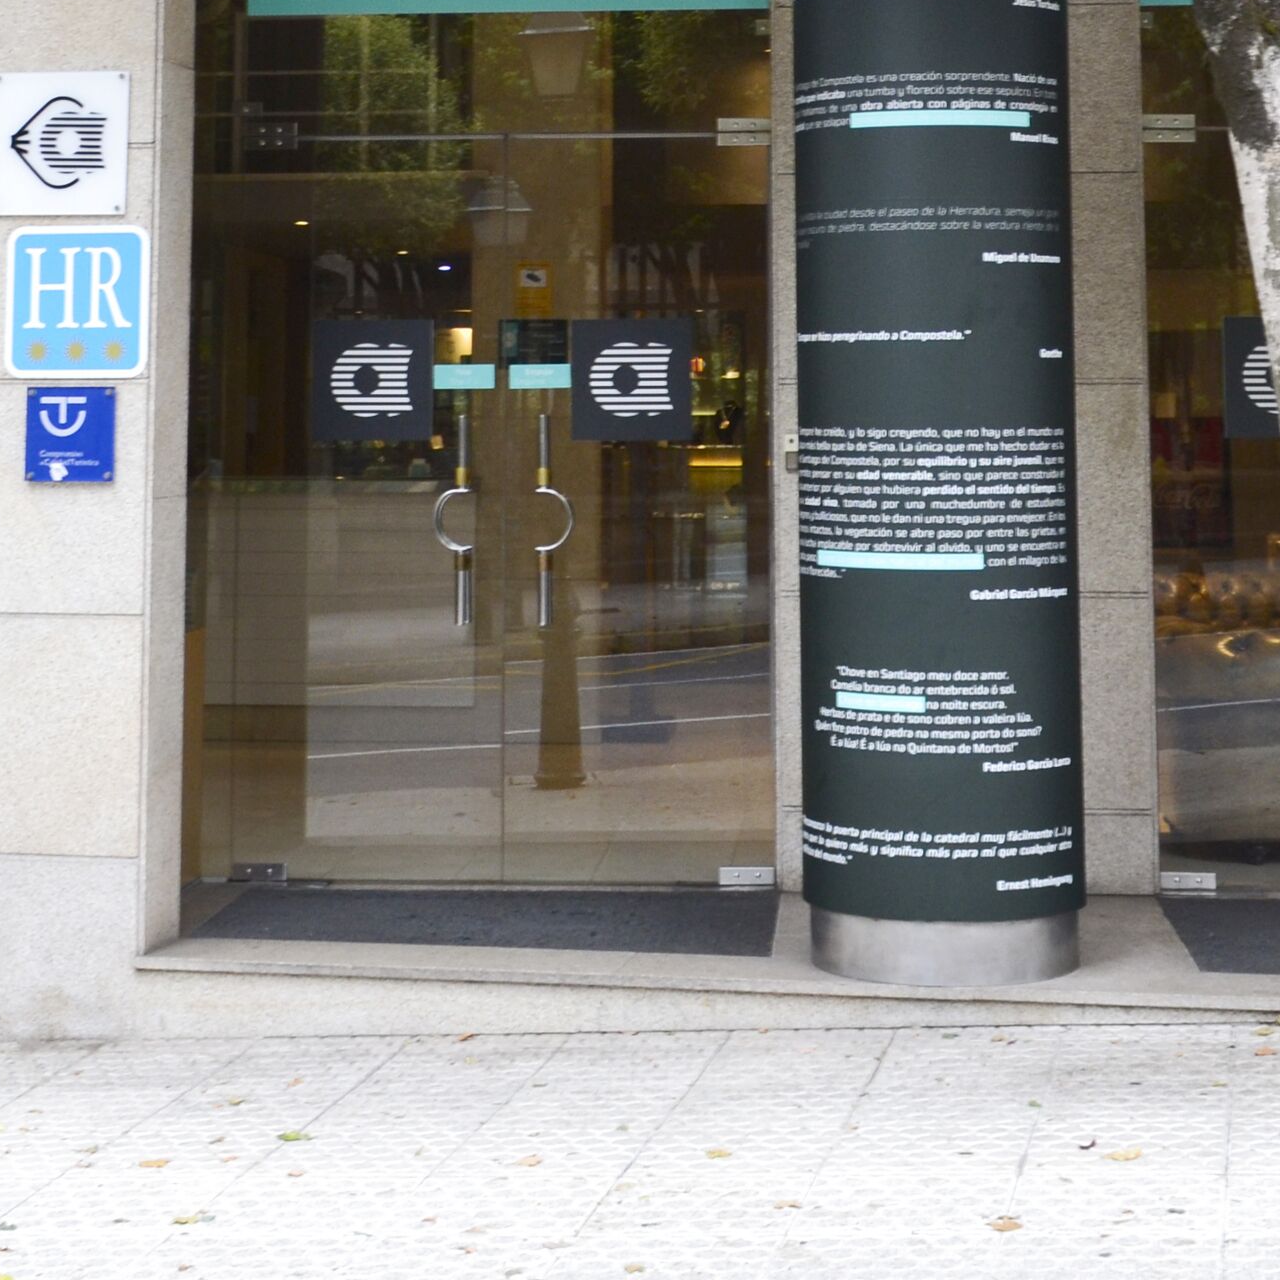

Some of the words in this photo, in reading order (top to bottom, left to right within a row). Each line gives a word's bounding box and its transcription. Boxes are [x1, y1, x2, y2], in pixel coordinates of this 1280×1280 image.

[879, 72, 898, 82] una
[899, 70, 942, 81] creación
[864, 87, 896, 97] tumba
[905, 84, 944, 95] floreció
[946, 84, 976, 95] sobre
[977, 86, 993, 95] ese
[860, 101, 883, 111] obra
[885, 99, 924, 110] abierta
[927, 100, 947, 109] con
[950, 98, 991, 110] páginas
[849, 208, 875, 218] desde
[888, 208, 919, 218] paseo
[921, 206, 935, 216] de
[869, 220, 937, 231] destacándose
[939, 220, 970, 231] sobre
[984, 221, 1021, 231] verdura
[982, 251, 1017, 264] Miguel
[22, 246, 133, 329] HR
[832, 330, 891, 343] peregrinando
[866, 427, 887, 439] sigo
[889, 426, 940, 439] creyendo,
[942, 428, 963, 439] que
[965, 429, 979, 438] no
[981, 426, 1000, 439] hay
[1002, 428, 1015, 437] en
[868, 441, 898, 452] Siena.
[900, 441, 913, 452] La
[915, 441, 943, 452] única
[945, 443, 965, 453] que
[966, 443, 984, 451] me
[985, 441, 999, 451] ha
[1000, 440, 1029, 451] hecho
[830, 454, 881, 466] Compostela,
[883, 457, 901, 467] por
[902, 458, 916, 467] su
[917, 455, 967, 468] equilibrio
[978, 457, 992, 466] su
[992, 455, 1012, 466] aire
[856, 469, 880, 480] edad
[881, 469, 936, 481] venerable,
[938, 470, 961, 481] sino
[963, 471, 984, 482] que
[985, 471, 1019, 482] parece
[833, 484, 862, 495] alguien
[863, 485, 881, 495] que
[882, 484, 921, 495] hubiera
[922, 484, 963, 496] perdido
[977, 484, 1015, 495] sentido
[1015, 483, 1030, 494] del
[842, 498, 877, 509] tomada
[881, 500, 900, 510] por
[905, 501, 926, 510] una
[930, 498, 1006, 509] muchedumbre
[1009, 498, 1023, 509] de
[868, 514, 881, 523] no
[892, 513, 911, 523] dan
[925, 515, 944, 524] una
[945, 514, 981, 526] tregua
[982, 515, 1006, 525] para
[844, 527, 893, 539] vegetación
[895, 529, 908, 538] se
[909, 528, 935, 538] abre
[936, 529, 963, 539] paso
[965, 529, 984, 539] por
[985, 527, 1014, 538] entre
[1015, 526, 1030, 537] las
[854, 542, 871, 552] por
[872, 541, 923, 552] sobrevivir
[937, 542, 973, 553] olvido,
[985, 543, 1005, 552] uno
[1006, 543, 1019, 552] se
[986, 558, 1006, 567] con
[969, 589, 1009, 600] Gabriel
[1009, 587, 1038, 599] García
[866, 669, 879, 678] en
[880, 668, 926, 682] Santiago
[927, 671, 951, 681] meu
[953, 670, 979, 681] doce
[980, 671, 1010, 680] amor.
[863, 682, 897, 694] branca
[897, 684, 912, 695] do
[912, 686, 925, 695] ar
[926, 684, 990, 696] entebrecida
[940, 699, 969, 710] noite
[970, 700, 1008, 710] escura.
[857, 711, 883, 722] prata
[891, 713, 907, 723] de
[907, 715, 933, 724] sono
[933, 714, 972, 725] cobren
[982, 713, 1016, 724] valeira
[870, 726, 883, 737] de
[883, 727, 914, 739] pedra
[915, 730, 929, 739] na
[930, 730, 970, 739] mesma
[971, 729, 1001, 741] porta
[1001, 727, 1015, 738] do
[892, 743, 907, 753] na
[907, 742, 956, 755] Quintana
[957, 743, 972, 754] de
[982, 760, 1026, 773] Federico
[1026, 757, 1053, 770] García
[860, 828, 903, 842] principal
[904, 831, 919, 842] de
[933, 832, 980, 844] catedral
[981, 833, 1006, 844] muy
[880, 844, 924, 858] significa
[925, 846, 951, 858] más
[952, 848, 979, 860] para
[997, 848, 1018, 858] que
[996, 879, 1029, 891] Ernest
